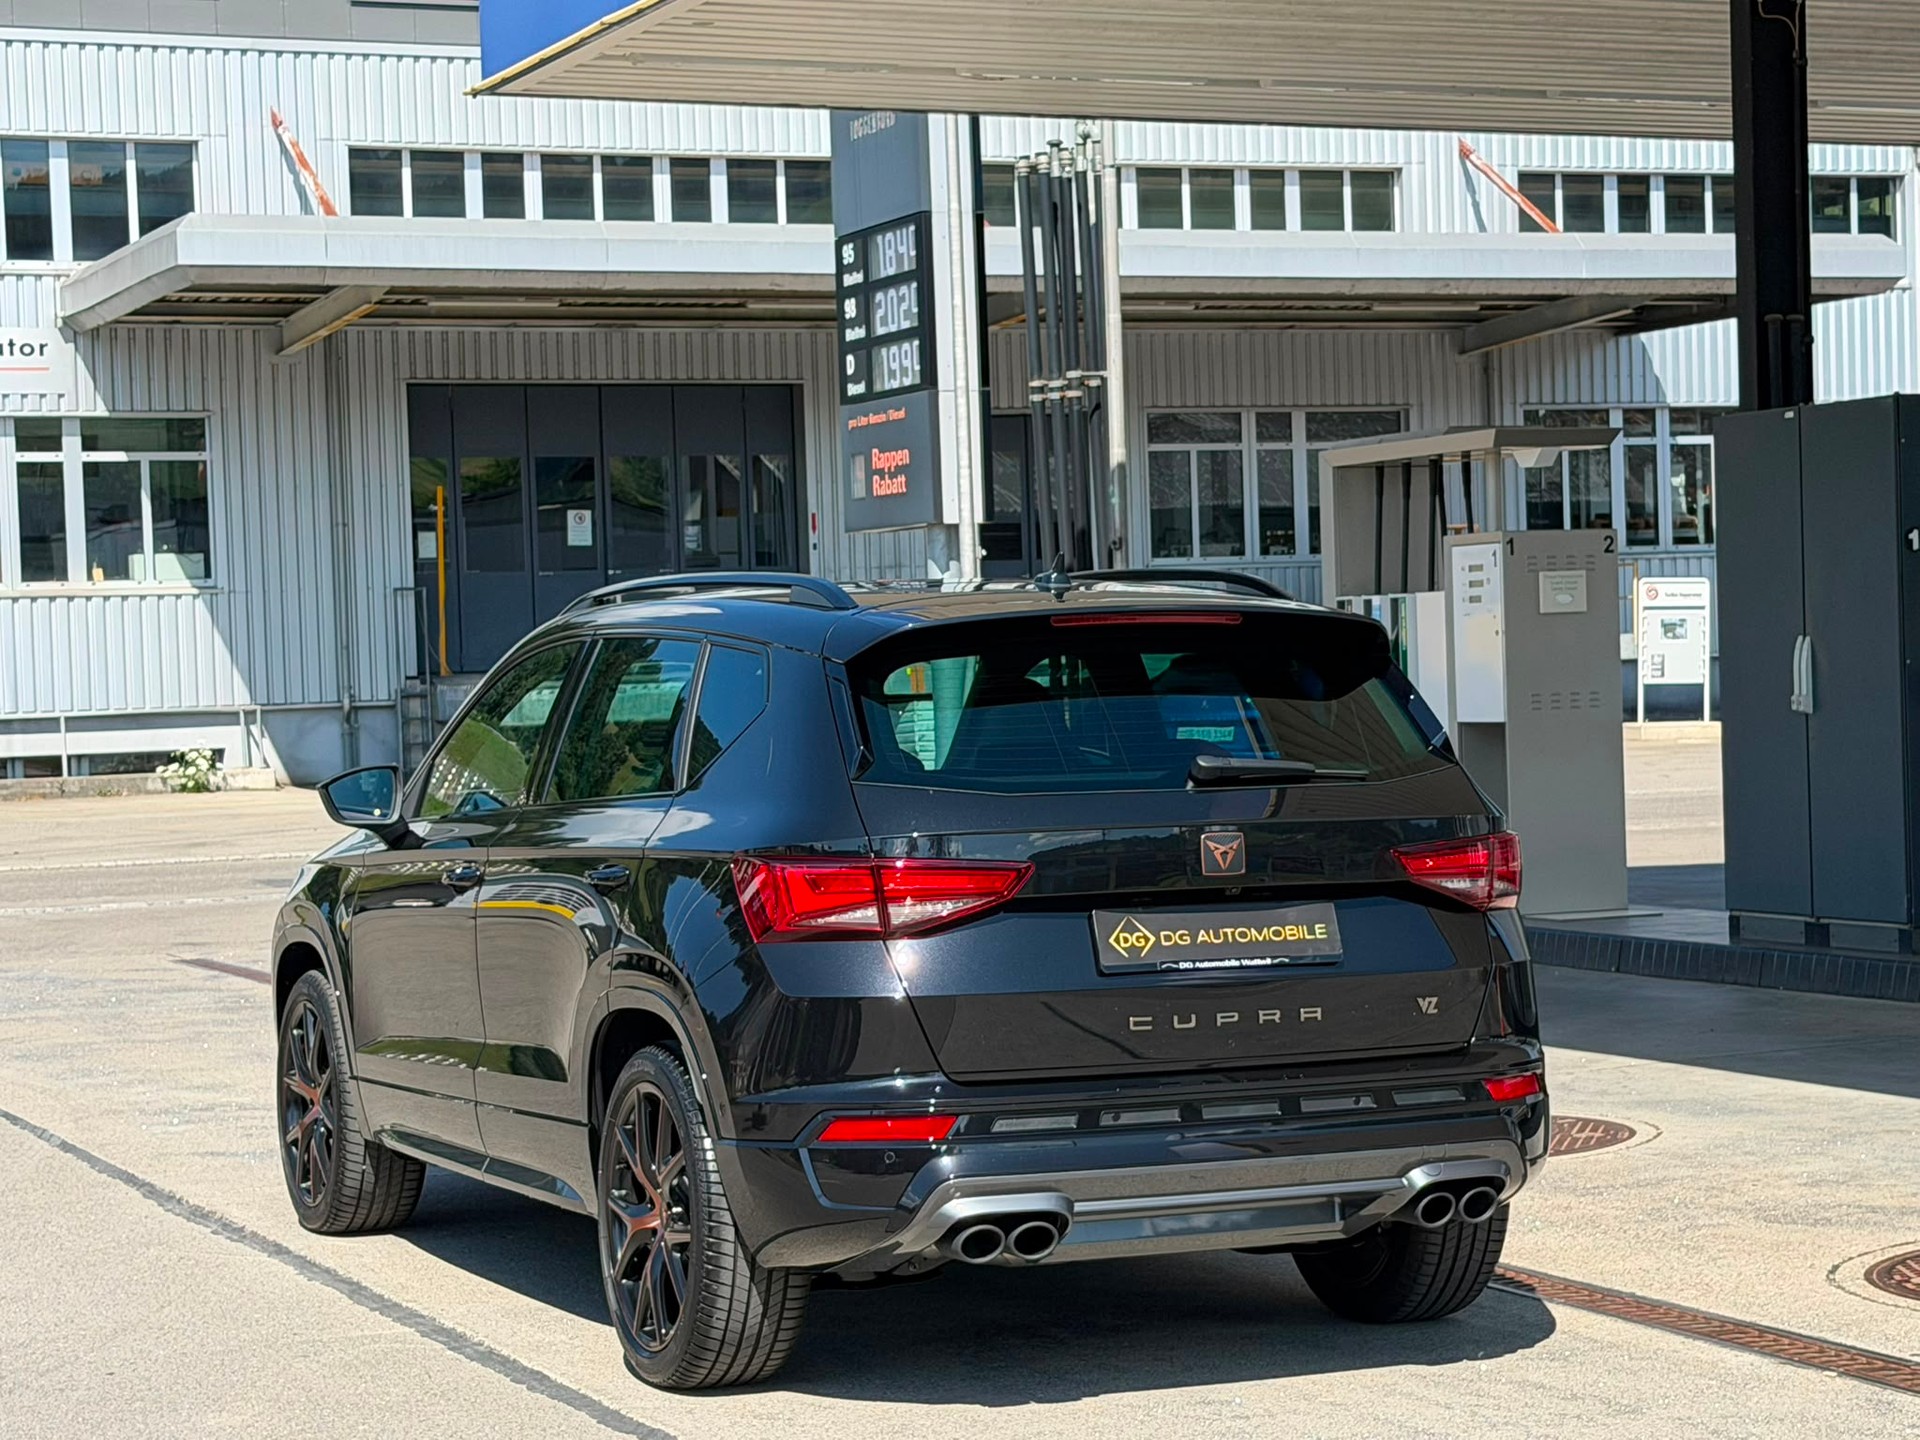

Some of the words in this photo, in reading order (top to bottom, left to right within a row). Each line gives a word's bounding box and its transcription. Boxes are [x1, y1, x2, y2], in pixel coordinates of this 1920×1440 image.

[842, 242, 855, 266] 95
[0, 338, 48, 357] tor
[846, 353, 855, 376] D
[872, 448, 910, 473] Rappen
[873, 473, 907, 497] Rabatt
[1506, 537, 1514, 556] 1
[1603, 535, 1614, 554] 2
[1908, 528, 1919, 551] 1
[1491, 548, 1497, 568] 1
[1118, 932, 1147, 948] DG
[1159, 929, 1191, 946] DG
[1197, 923, 1328, 944] AUTOMOBILE
[1179, 961, 1193, 969] DG
[1195, 959, 1240, 968] Automobile
[1416, 996, 1439, 1014] VZ
[1129, 1006, 1322, 1031] CUPRA
